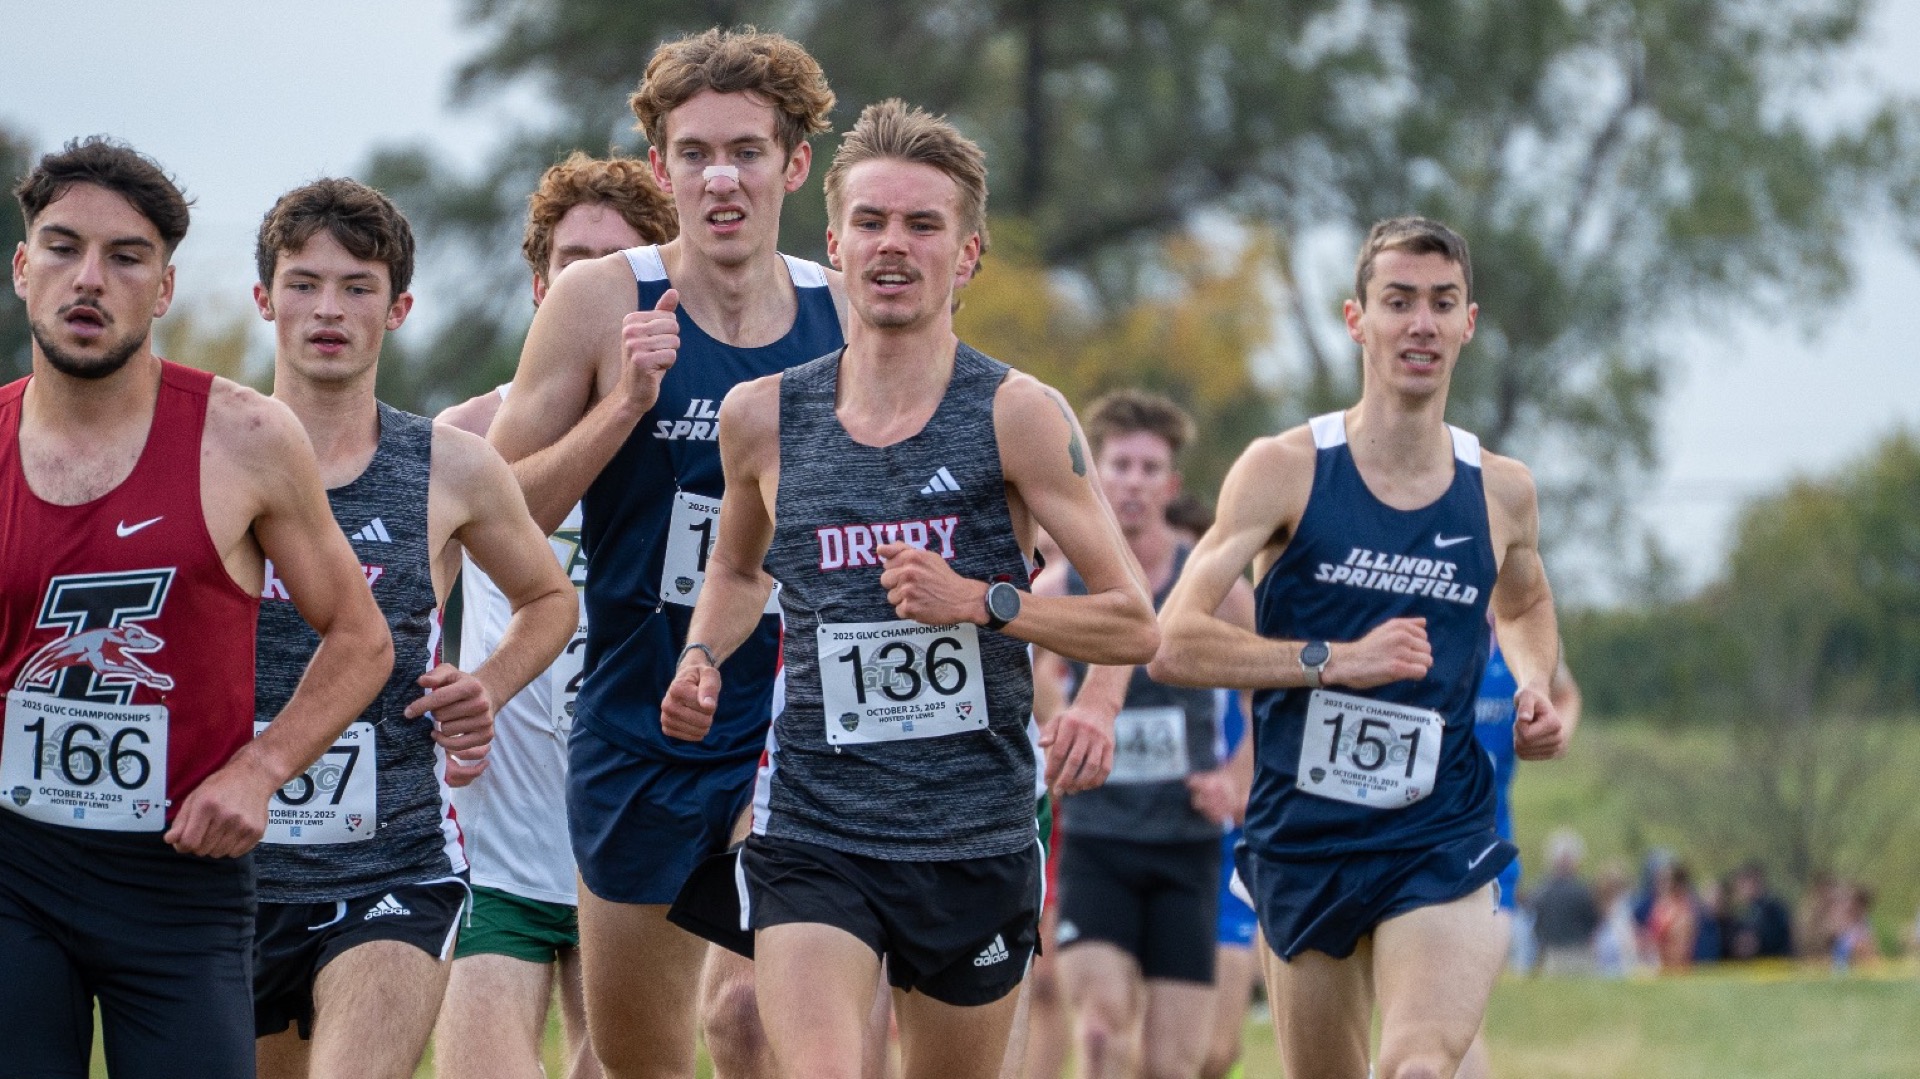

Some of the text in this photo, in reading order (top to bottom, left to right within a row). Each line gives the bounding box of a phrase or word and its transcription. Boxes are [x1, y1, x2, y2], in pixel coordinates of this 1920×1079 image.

[683, 398, 723, 418] IL
[688, 502, 709, 513] 2025
[816, 514, 960, 573] DRURY
[1344, 547, 1458, 581] ILLINOIS
[1313, 561, 1480, 605] SPRINGFIELD
[833, 624, 960, 640] 2025 GLVC CHAMPIONSHIPS
[838, 636, 967, 705] 136
[22, 700, 151, 722] 2025 GLVC CHAMPIONSHIPS
[866, 701, 946, 717] OCTOBER 25, 2025
[1323, 699, 1431, 725] 2025 GLVC CHAMPIONSHIPS
[879, 715, 904, 723] HOSTED
[24, 716, 150, 790] 166
[1323, 712, 1422, 779] 151
[1332, 769, 1367, 781] OCTOBER
[39, 787, 82, 799] OCTOBER
[84, 793, 98, 801] 25,
[100, 793, 123, 802] 2025
[51, 798, 78, 806] HOSTED
[89, 801, 109, 809] LEWIS
[299, 811, 313, 819] 25,
[314, 811, 336, 819] 2025
[363, 907, 411, 921] adidas
[973, 950, 1009, 967] adidas
